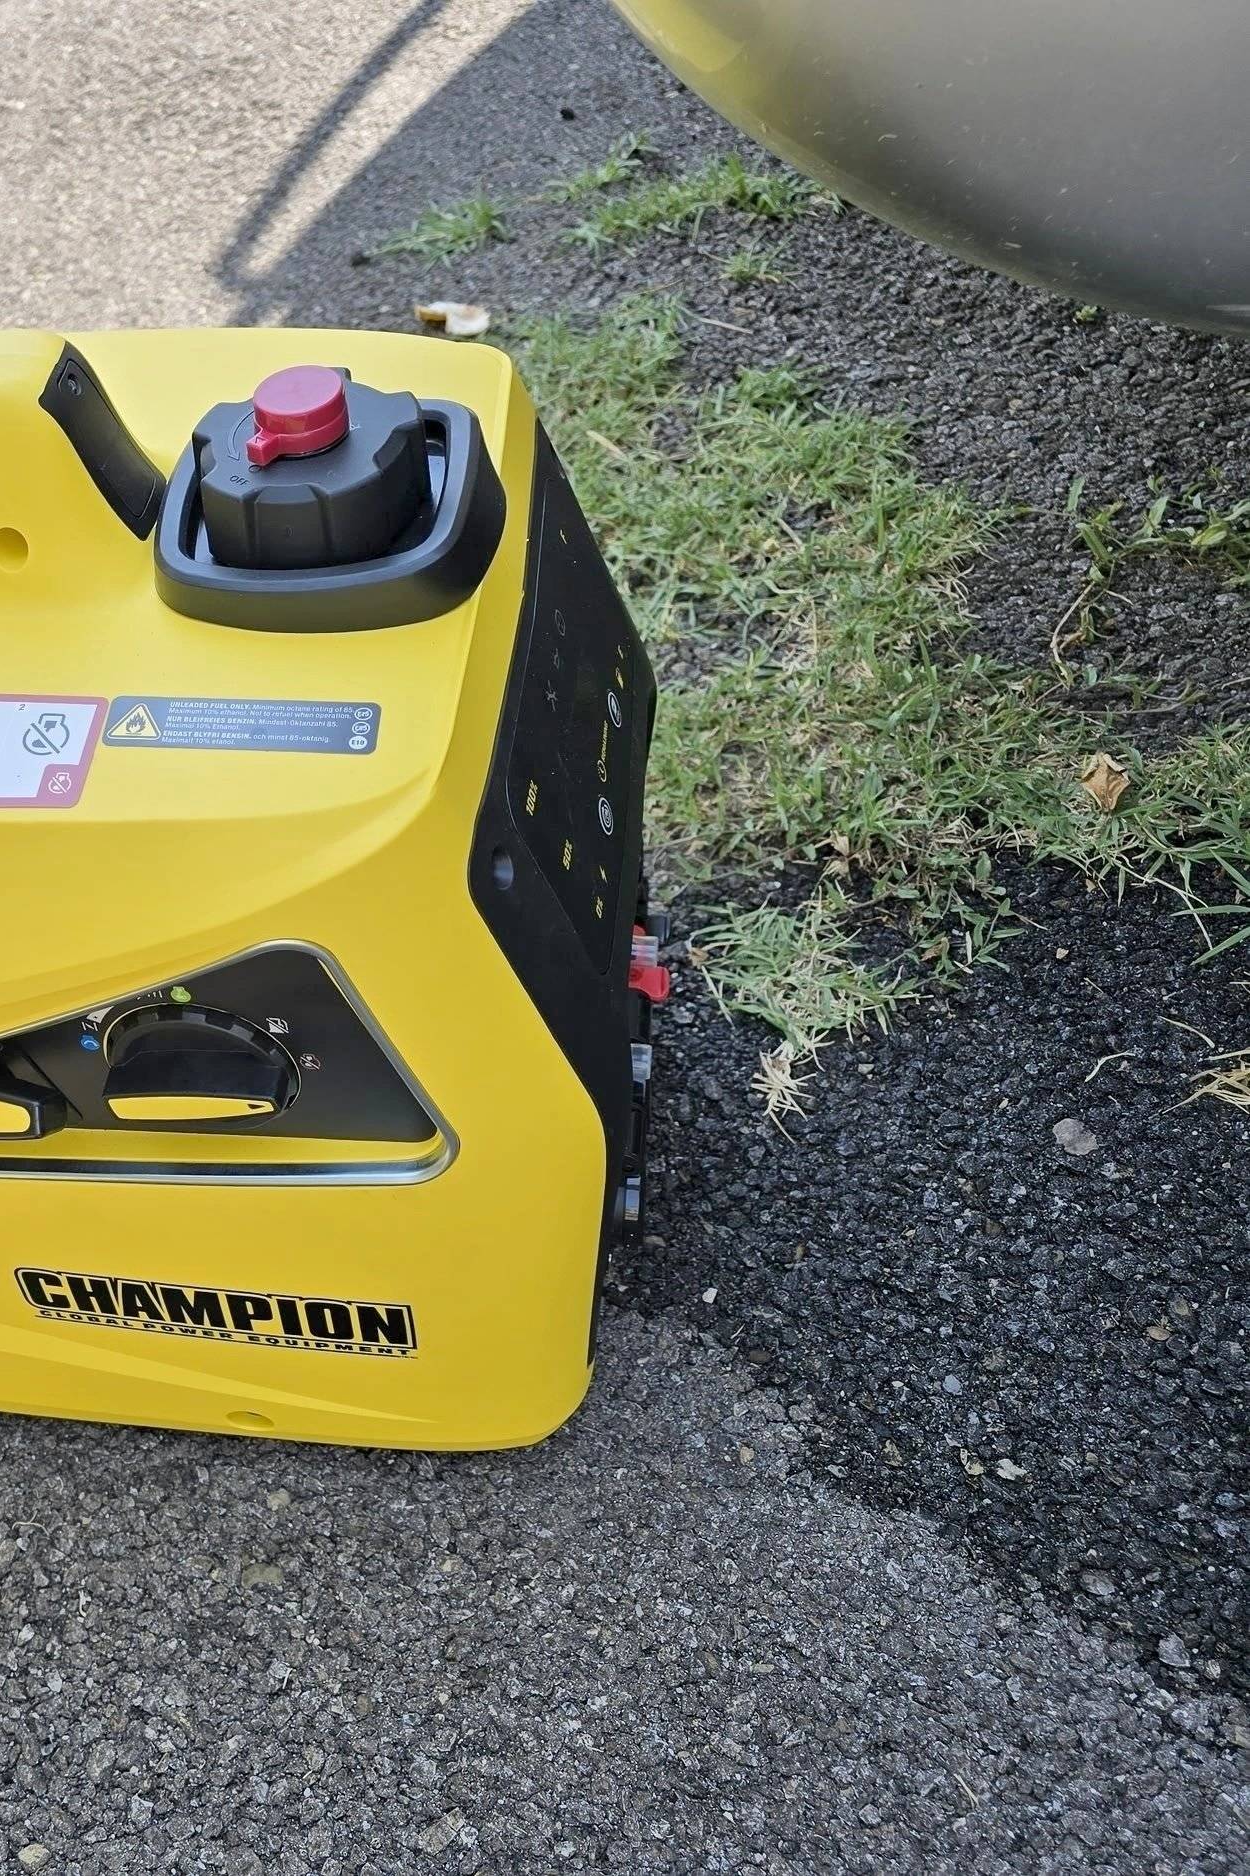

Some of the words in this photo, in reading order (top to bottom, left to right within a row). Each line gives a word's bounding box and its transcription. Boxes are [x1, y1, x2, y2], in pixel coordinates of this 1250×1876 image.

[229, 475, 250, 485] OFF
[18, 703, 26, 712] 2
[210, 702, 228, 710] FUEL
[312, 706, 333, 714] rating
[184, 716, 226, 724] BLEIFREIES
[525, 779, 538, 816] 100%
[562, 838, 573, 871] 50%
[595, 896, 604, 919] 0%
[19, 1268, 412, 1347] CHAMPION
[39, 1309, 134, 1327] GLOBAL
[142, 1322, 235, 1341] POWER
[247, 1334, 411, 1356] EQUIPMENT
